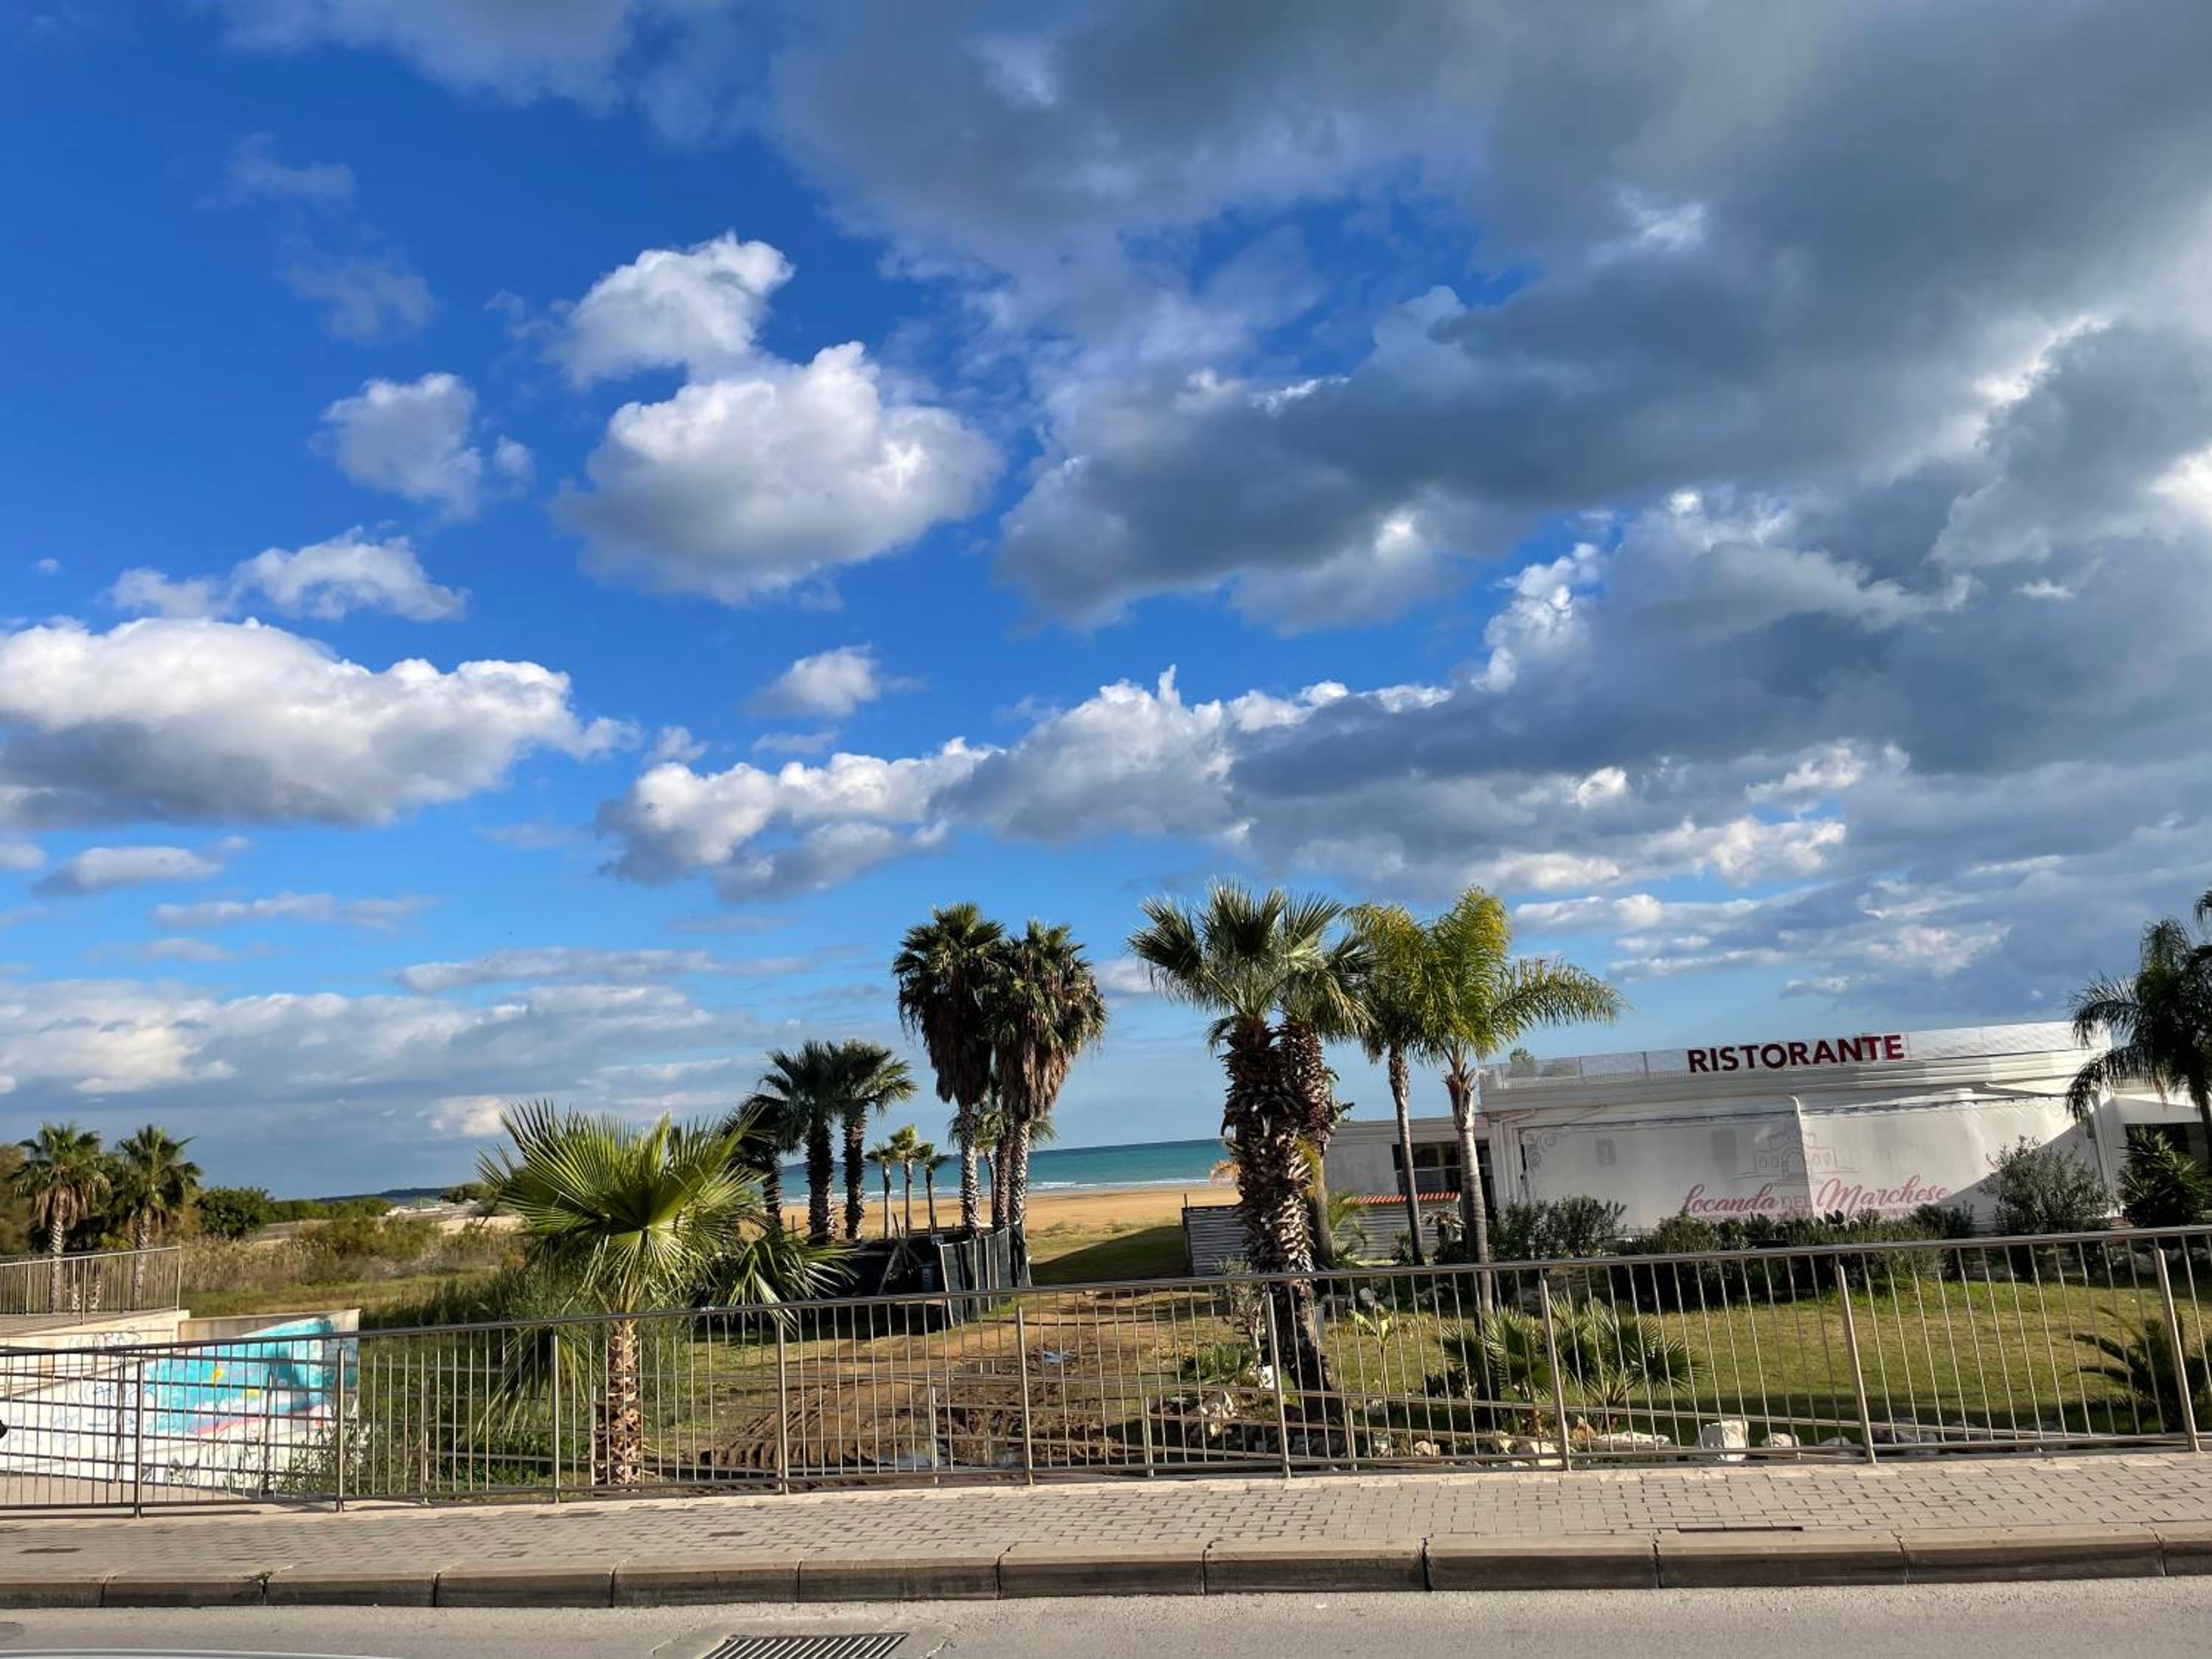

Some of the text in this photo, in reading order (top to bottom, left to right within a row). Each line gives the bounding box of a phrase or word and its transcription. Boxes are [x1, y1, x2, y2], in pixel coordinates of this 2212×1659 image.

[1687, 1034, 1905, 1073] RISTORANTE
[1682, 1183, 1775, 1213] Locanda
[1816, 1175, 1947, 1217] Marchese
